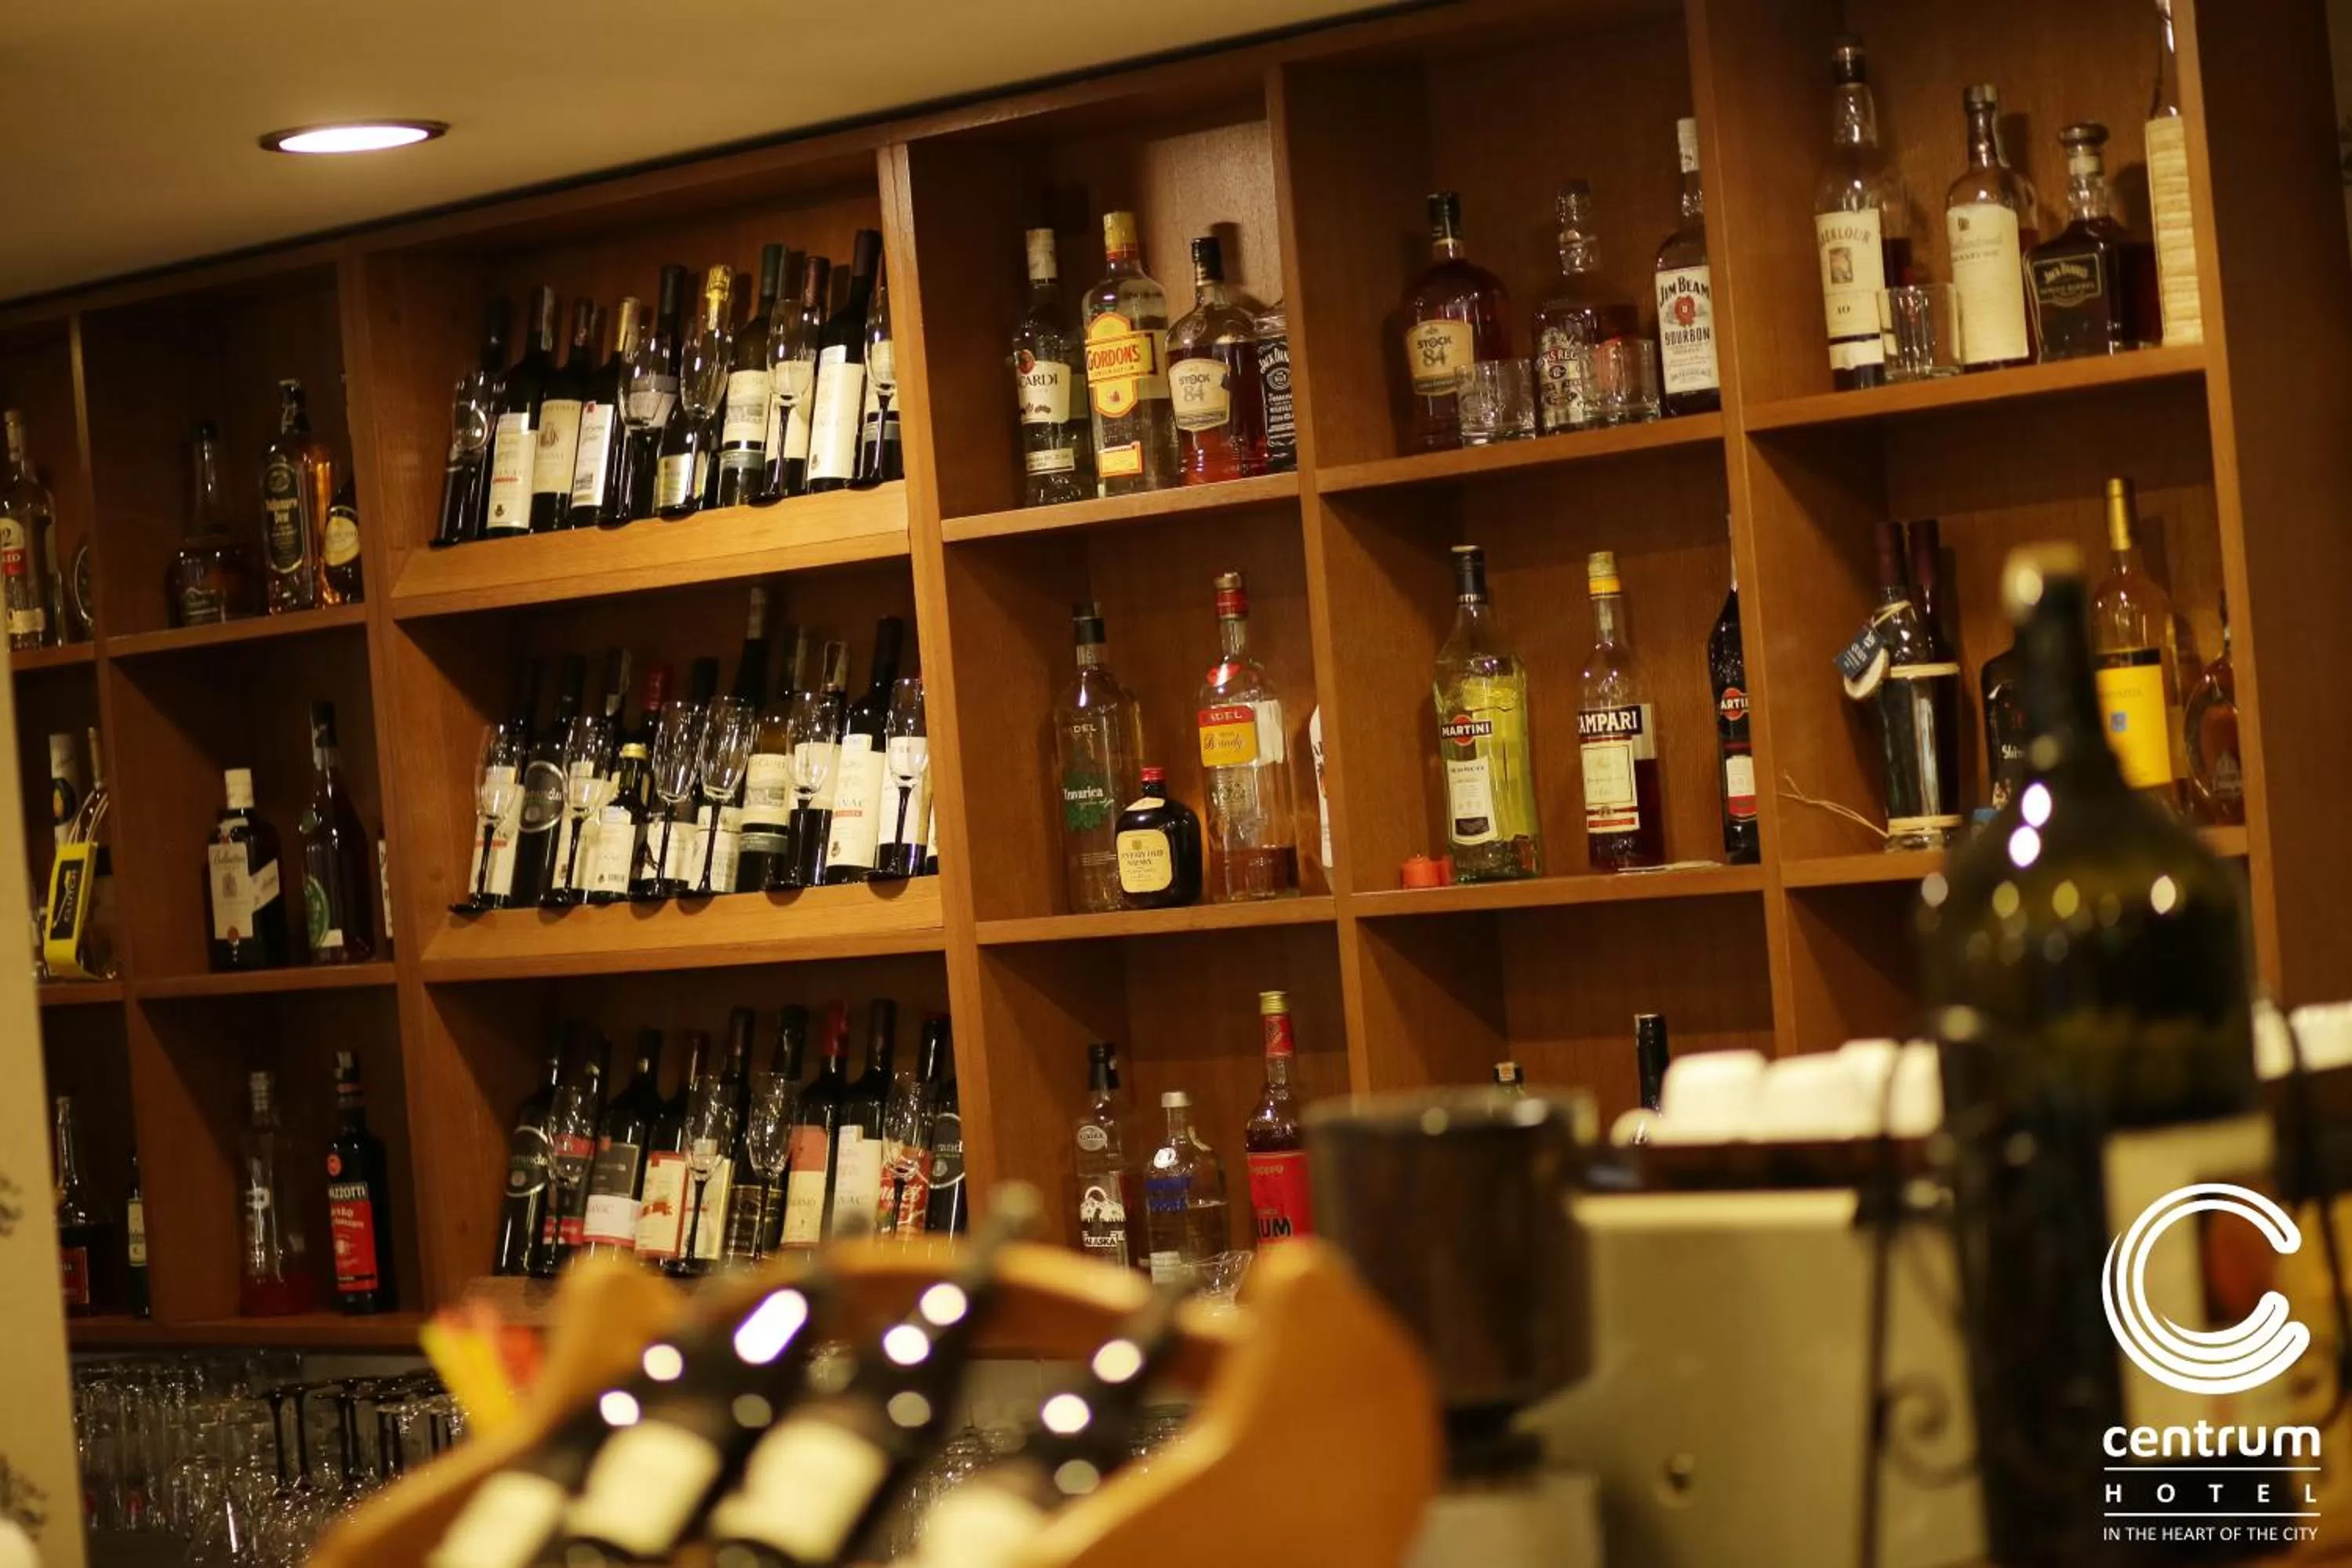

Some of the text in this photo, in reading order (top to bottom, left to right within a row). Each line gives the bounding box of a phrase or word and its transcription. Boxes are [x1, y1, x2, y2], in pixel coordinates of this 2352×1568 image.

[1659, 276, 1710, 307] JIM BEAM
[1416, 336, 1452, 350] STOCK
[1664, 326, 1710, 346] BOURBON
[1423, 347, 1446, 368] 84
[1018, 372, 1058, 389] CARDI
[1179, 374, 1210, 385] STOCK
[1184, 383, 1205, 402] 84
[1442, 723, 1490, 737] MARTINI
[1577, 710, 1638, 734] AMPARI
[1257, 1216, 1292, 1237] UM
